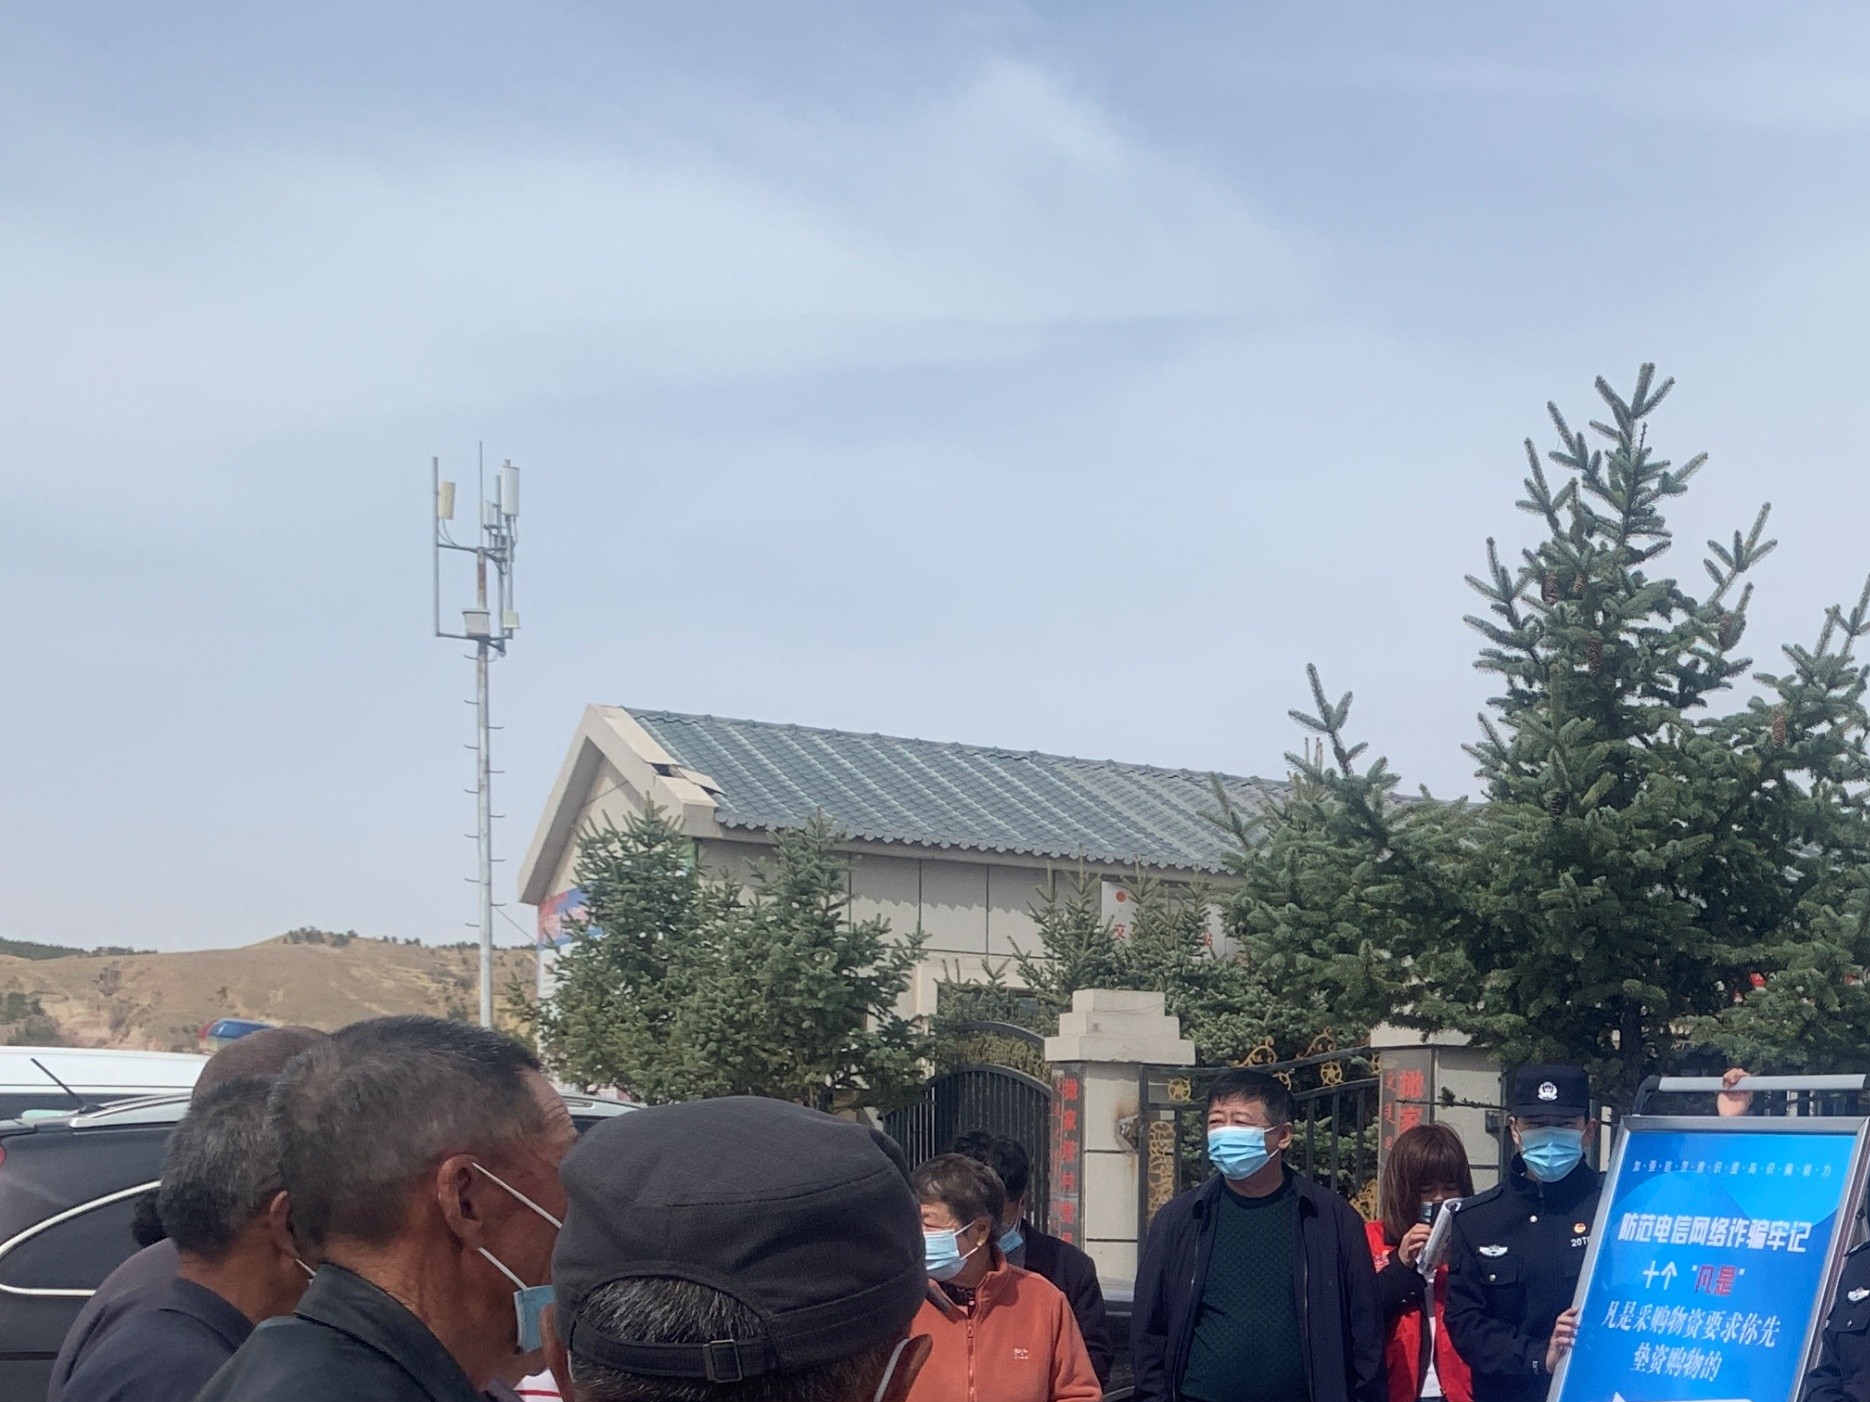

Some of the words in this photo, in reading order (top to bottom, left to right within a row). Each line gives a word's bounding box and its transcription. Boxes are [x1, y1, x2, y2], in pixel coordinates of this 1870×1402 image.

[1617, 1211, 1813, 1253] 防范电信网络诈骗牢记
[1601, 1300, 1781, 1349] 凡是采购物资要求你先
[1629, 1341, 1724, 1382] 垫资购物的
